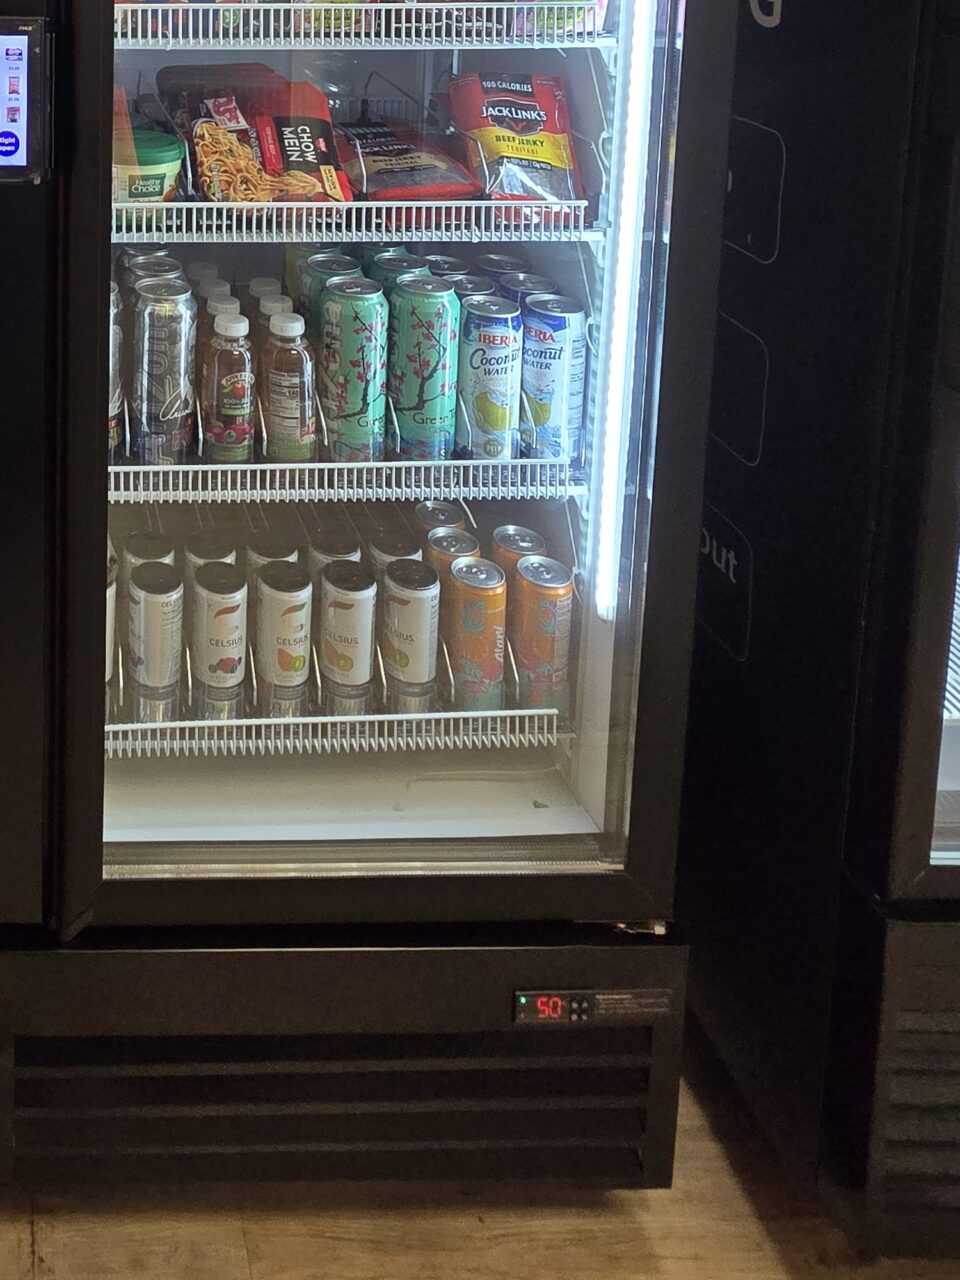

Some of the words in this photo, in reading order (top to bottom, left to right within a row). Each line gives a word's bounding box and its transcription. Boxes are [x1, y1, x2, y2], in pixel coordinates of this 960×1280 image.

[482, 80, 497, 88] 100
[497, 81, 533, 92] CALORIES
[481, 105, 512, 118] JACK
[280, 127, 304, 162] MEIN
[296, 125, 318, 164] CHOW
[495, 134, 516, 143] BEEF
[517, 137, 545, 147] JERKY
[478, 333, 518, 347] IBERIA
[469, 347, 521, 370] Coconut
[483, 365, 515, 376] WATER
[209, 635, 244, 648] CELSIUS
[276, 634, 309, 646] CELSIUS
[493, 625, 505, 664] Alani
[536, 995, 563, 1019] 50
